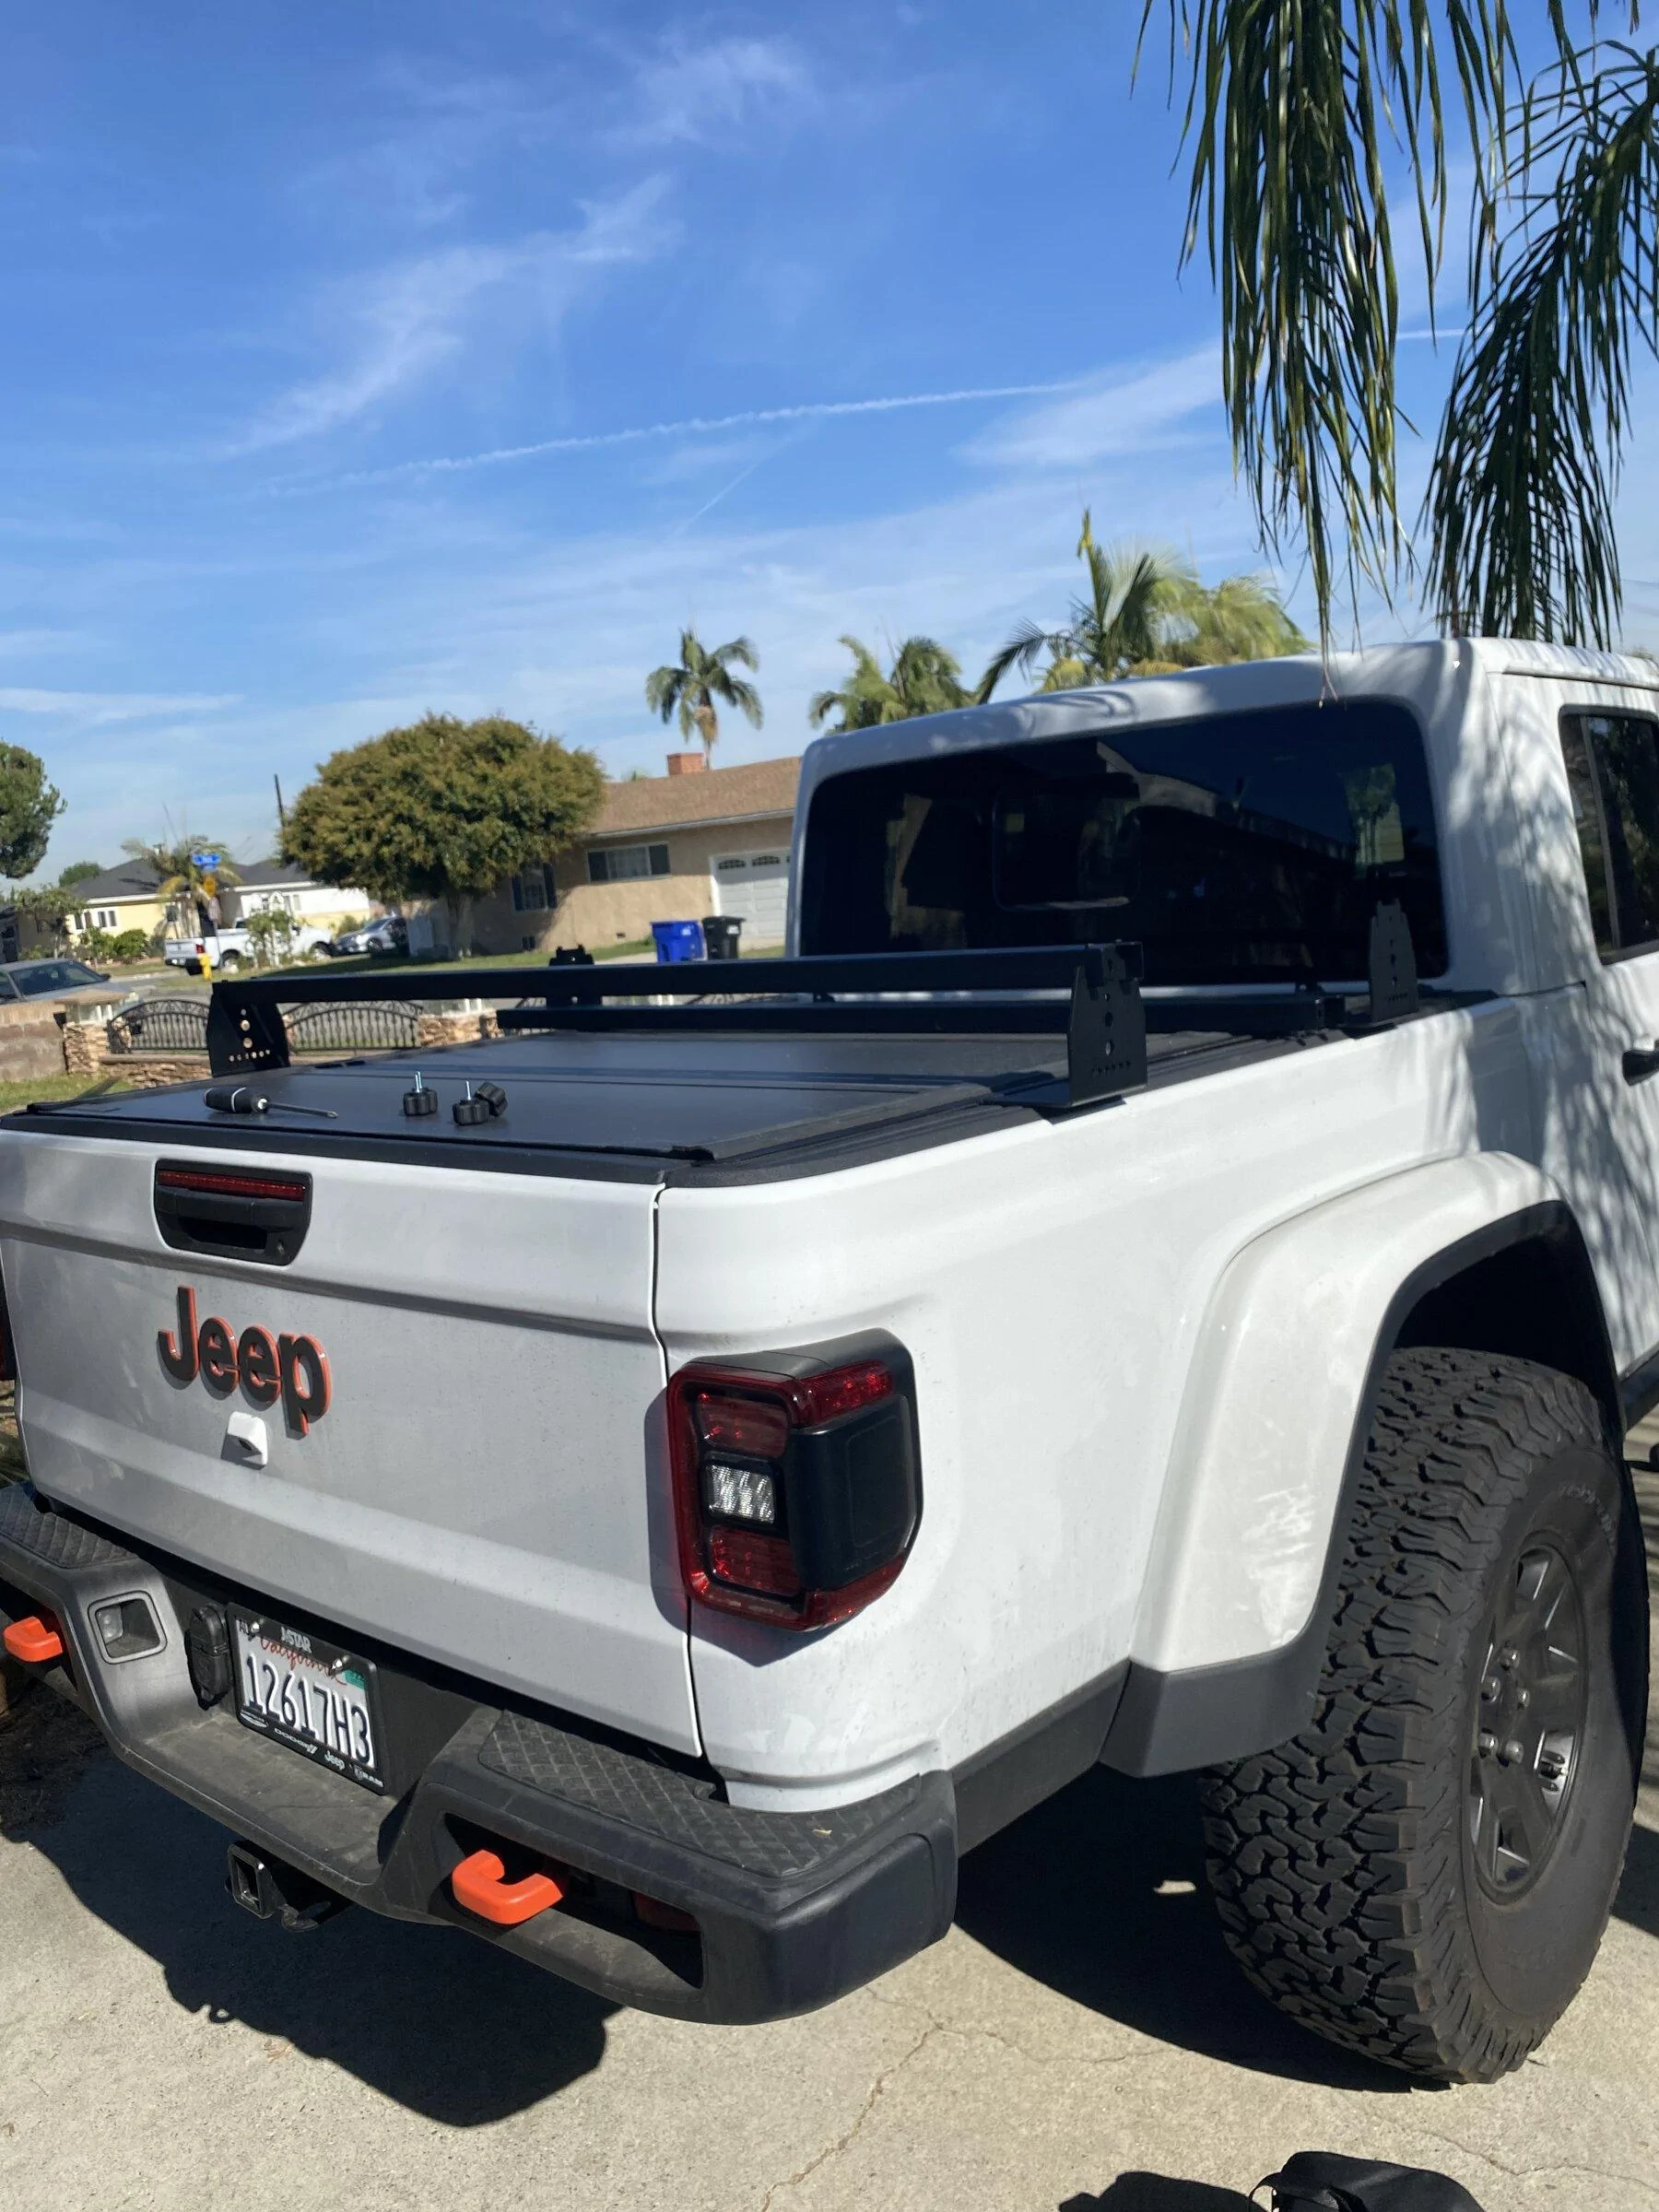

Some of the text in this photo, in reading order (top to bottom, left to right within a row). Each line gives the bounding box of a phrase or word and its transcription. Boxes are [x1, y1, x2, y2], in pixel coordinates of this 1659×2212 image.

[158, 1285, 332, 1436] Jeep
[247, 1652, 373, 1767] 12617H3
[324, 1749, 346, 1771] Jeep
